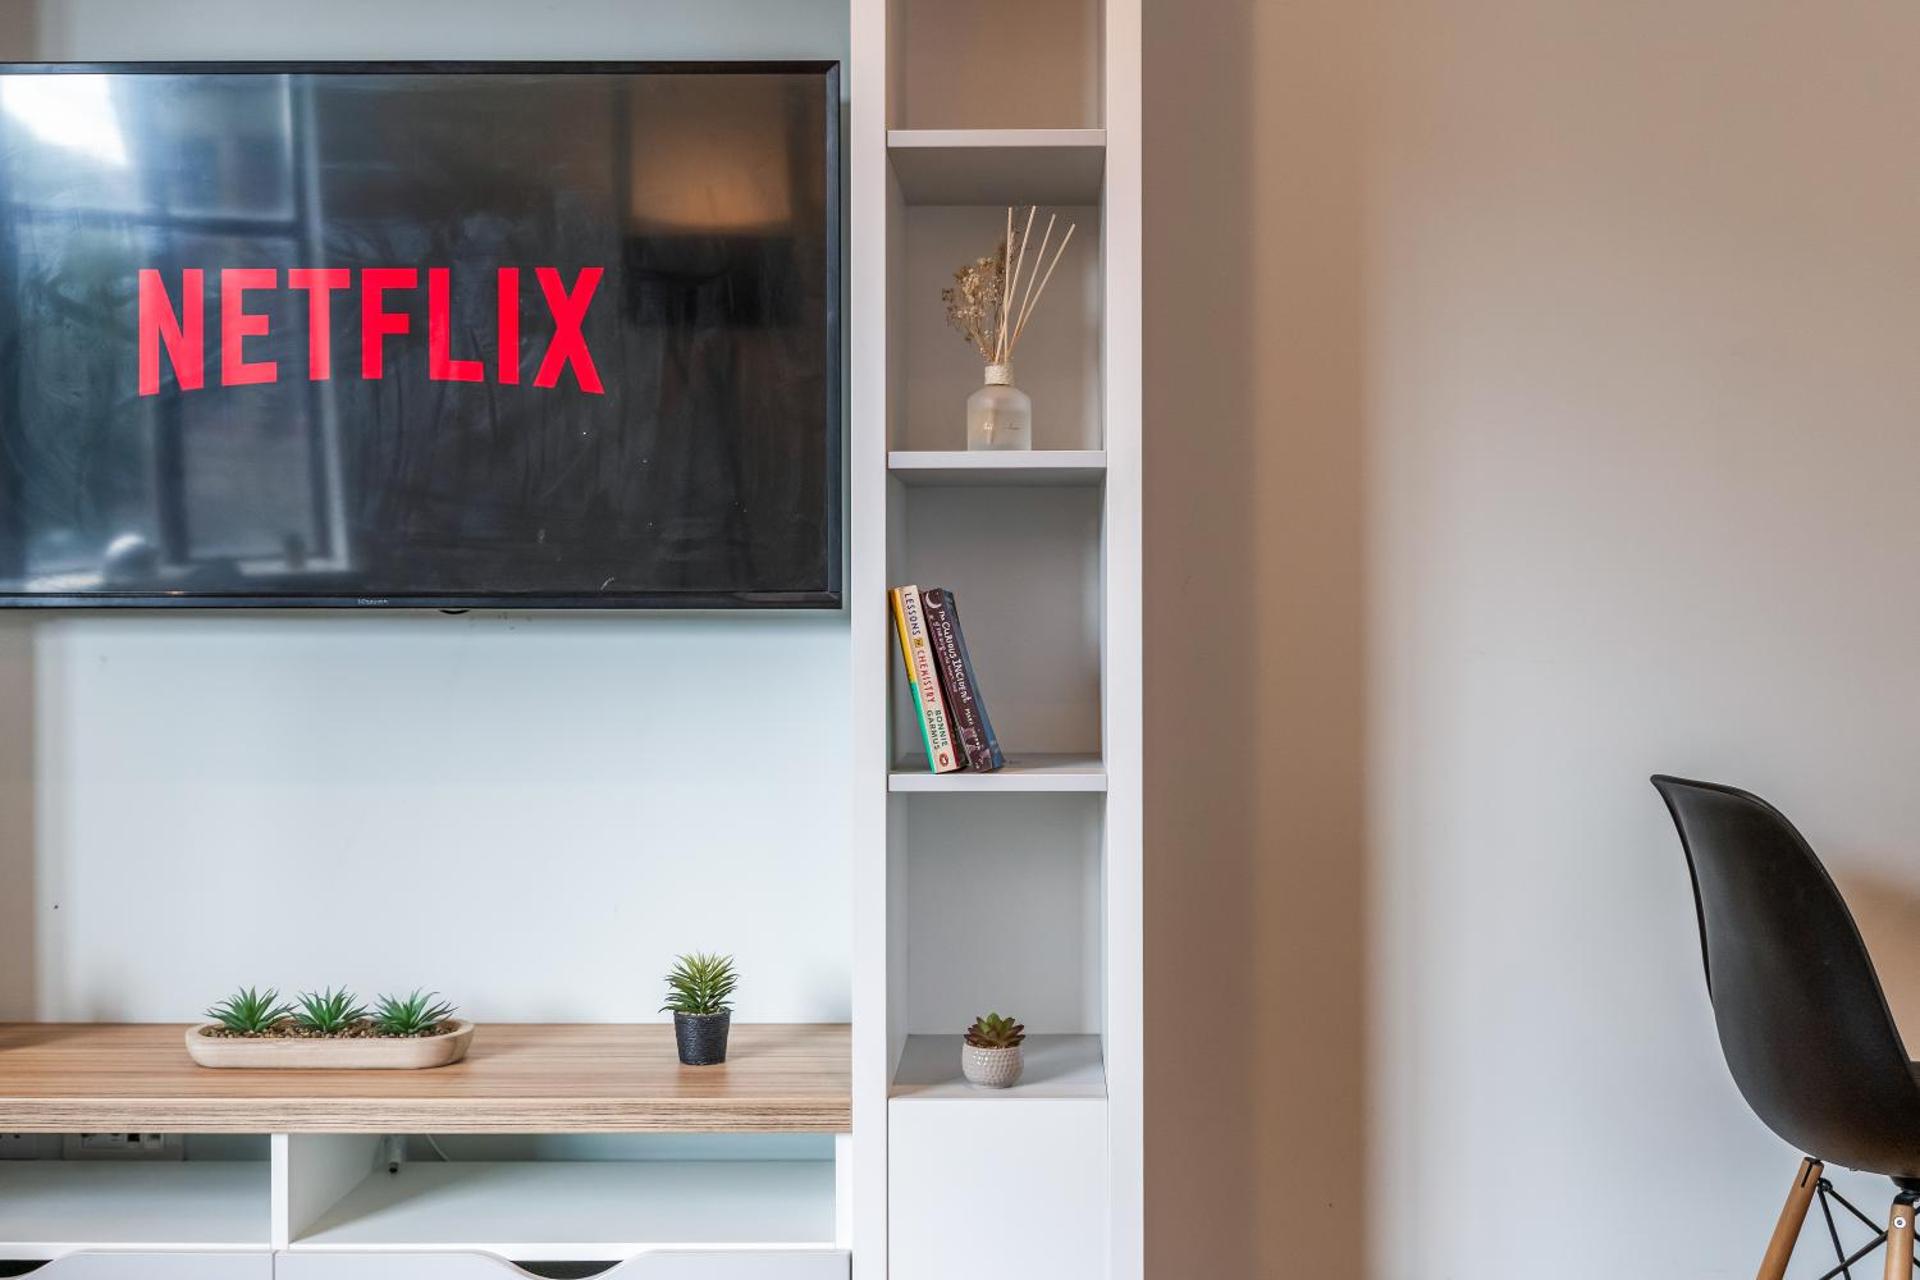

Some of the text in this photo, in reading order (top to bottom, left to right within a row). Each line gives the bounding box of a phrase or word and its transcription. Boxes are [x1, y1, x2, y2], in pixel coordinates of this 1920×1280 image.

[138, 267, 605, 396] NETFLIX
[904, 592, 921, 636] LESSONS
[917, 649, 936, 703] CHEMISTRY
[926, 709, 941, 750] GARMUS
[934, 709, 949, 747] BONNIE
